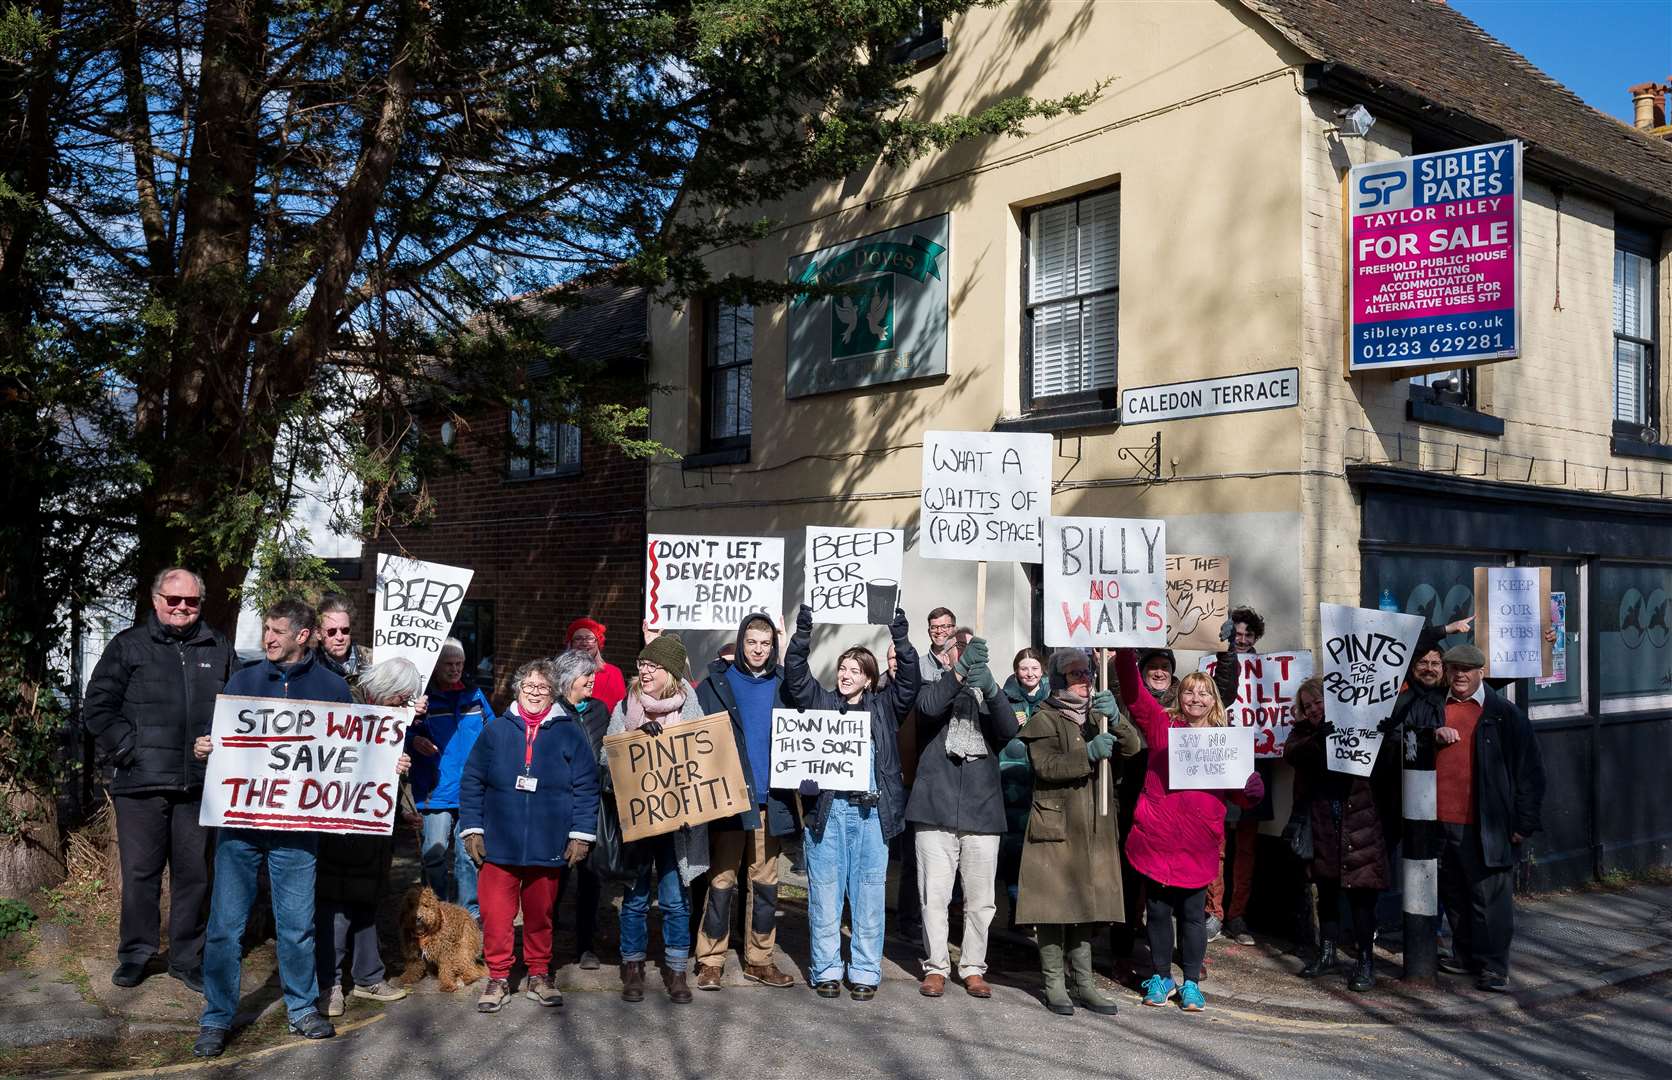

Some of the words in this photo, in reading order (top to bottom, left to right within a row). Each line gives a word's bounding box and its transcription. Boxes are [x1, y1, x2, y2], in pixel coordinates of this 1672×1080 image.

[1421, 149, 1506, 181] SIBLEY
[1424, 173, 1503, 203] PARES
[1364, 208, 1436, 228] TAYLOR
[1445, 199, 1501, 217] RILEY
[1359, 233, 1420, 261] FOR
[1429, 221, 1508, 253] SALE
[856, 250, 916, 270] Doves
[1359, 261, 1417, 275] FREEHOLD
[1421, 255, 1463, 268] PUBLIC
[1467, 250, 1507, 263] HOUSE
[1380, 273, 1484, 293] ACCOMMODATION
[1393, 269, 1424, 281] WITH
[1428, 265, 1470, 277] LIVING
[1365, 298, 1442, 314] ALTERNATIVE
[1445, 295, 1475, 306] USES
[1478, 292, 1501, 303] STP
[1373, 293, 1396, 303] MAY
[1401, 291, 1413, 301] BE
[1417, 285, 1473, 299] SUITABLE
[1477, 282, 1501, 292] FOR
[1363, 315, 1503, 340] sibleypares.co.uk
[1363, 341, 1421, 359] 01233
[1429, 333, 1503, 353] 629281
[1128, 390, 1201, 414] CALEDON
[1211, 379, 1290, 405] TERRACE
[933, 443, 992, 474] WHAT
[1002, 448, 1022, 475] A
[924, 487, 1000, 511] WAITTS
[1012, 490, 1038, 511] OF
[930, 513, 979, 545] (PUB)
[986, 516, 1042, 547] SPACE!
[658, 539, 719, 559] DON'T
[727, 541, 762, 559] LET
[812, 531, 895, 562] BEEP
[1061, 526, 1160, 576] BILLY
[666, 561, 780, 581] DEVELOPERS
[813, 562, 864, 584] FOR
[1166, 557, 1186, 570] ET
[1190, 558, 1221, 571] THE
[695, 583, 752, 603] BEND
[1090, 580, 1120, 600] NO
[1196, 579, 1229, 593] FREE
[1497, 579, 1534, 591] KEEP
[383, 578, 464, 623] BEER
[811, 582, 866, 612] BEER
[660, 604, 702, 622] THE
[1062, 600, 1163, 638] WAITS
[1500, 604, 1532, 616] OUR
[390, 614, 444, 631] BEFORE
[1500, 627, 1534, 639] PUBS
[374, 629, 442, 653] BEDSITS
[1326, 632, 1407, 667] PINTS
[1350, 662, 1377, 673] FOR
[1350, 673, 1376, 684] THE
[1237, 682, 1292, 704] ILL
[1323, 672, 1400, 706] PEOPLE!
[234, 708, 316, 735] STOP
[326, 711, 405, 746] WATES
[776, 716, 822, 734] DOWN
[827, 719, 864, 738] WITH
[1335, 727, 1354, 736] AVE
[1358, 729, 1378, 739] THE
[775, 737, 816, 753] THIS
[822, 739, 867, 756] SORT
[1179, 734, 1200, 747] SAY
[1208, 733, 1226, 747] NO
[1329, 735, 1360, 748] TWO
[268, 744, 359, 774] SAVE
[629, 730, 713, 773] PINTS
[1175, 749, 1191, 762] TO
[1195, 747, 1238, 762] CHANGE
[1335, 748, 1371, 764] DOVES
[641, 761, 703, 793] OVER
[775, 759, 797, 773] OF
[802, 760, 853, 778] THING
[1186, 765, 1200, 776] OF
[1204, 763, 1226, 775] USE
[222, 777, 290, 808] THE
[298, 778, 394, 818] DOVES
[629, 776, 732, 825] PROFIT!
